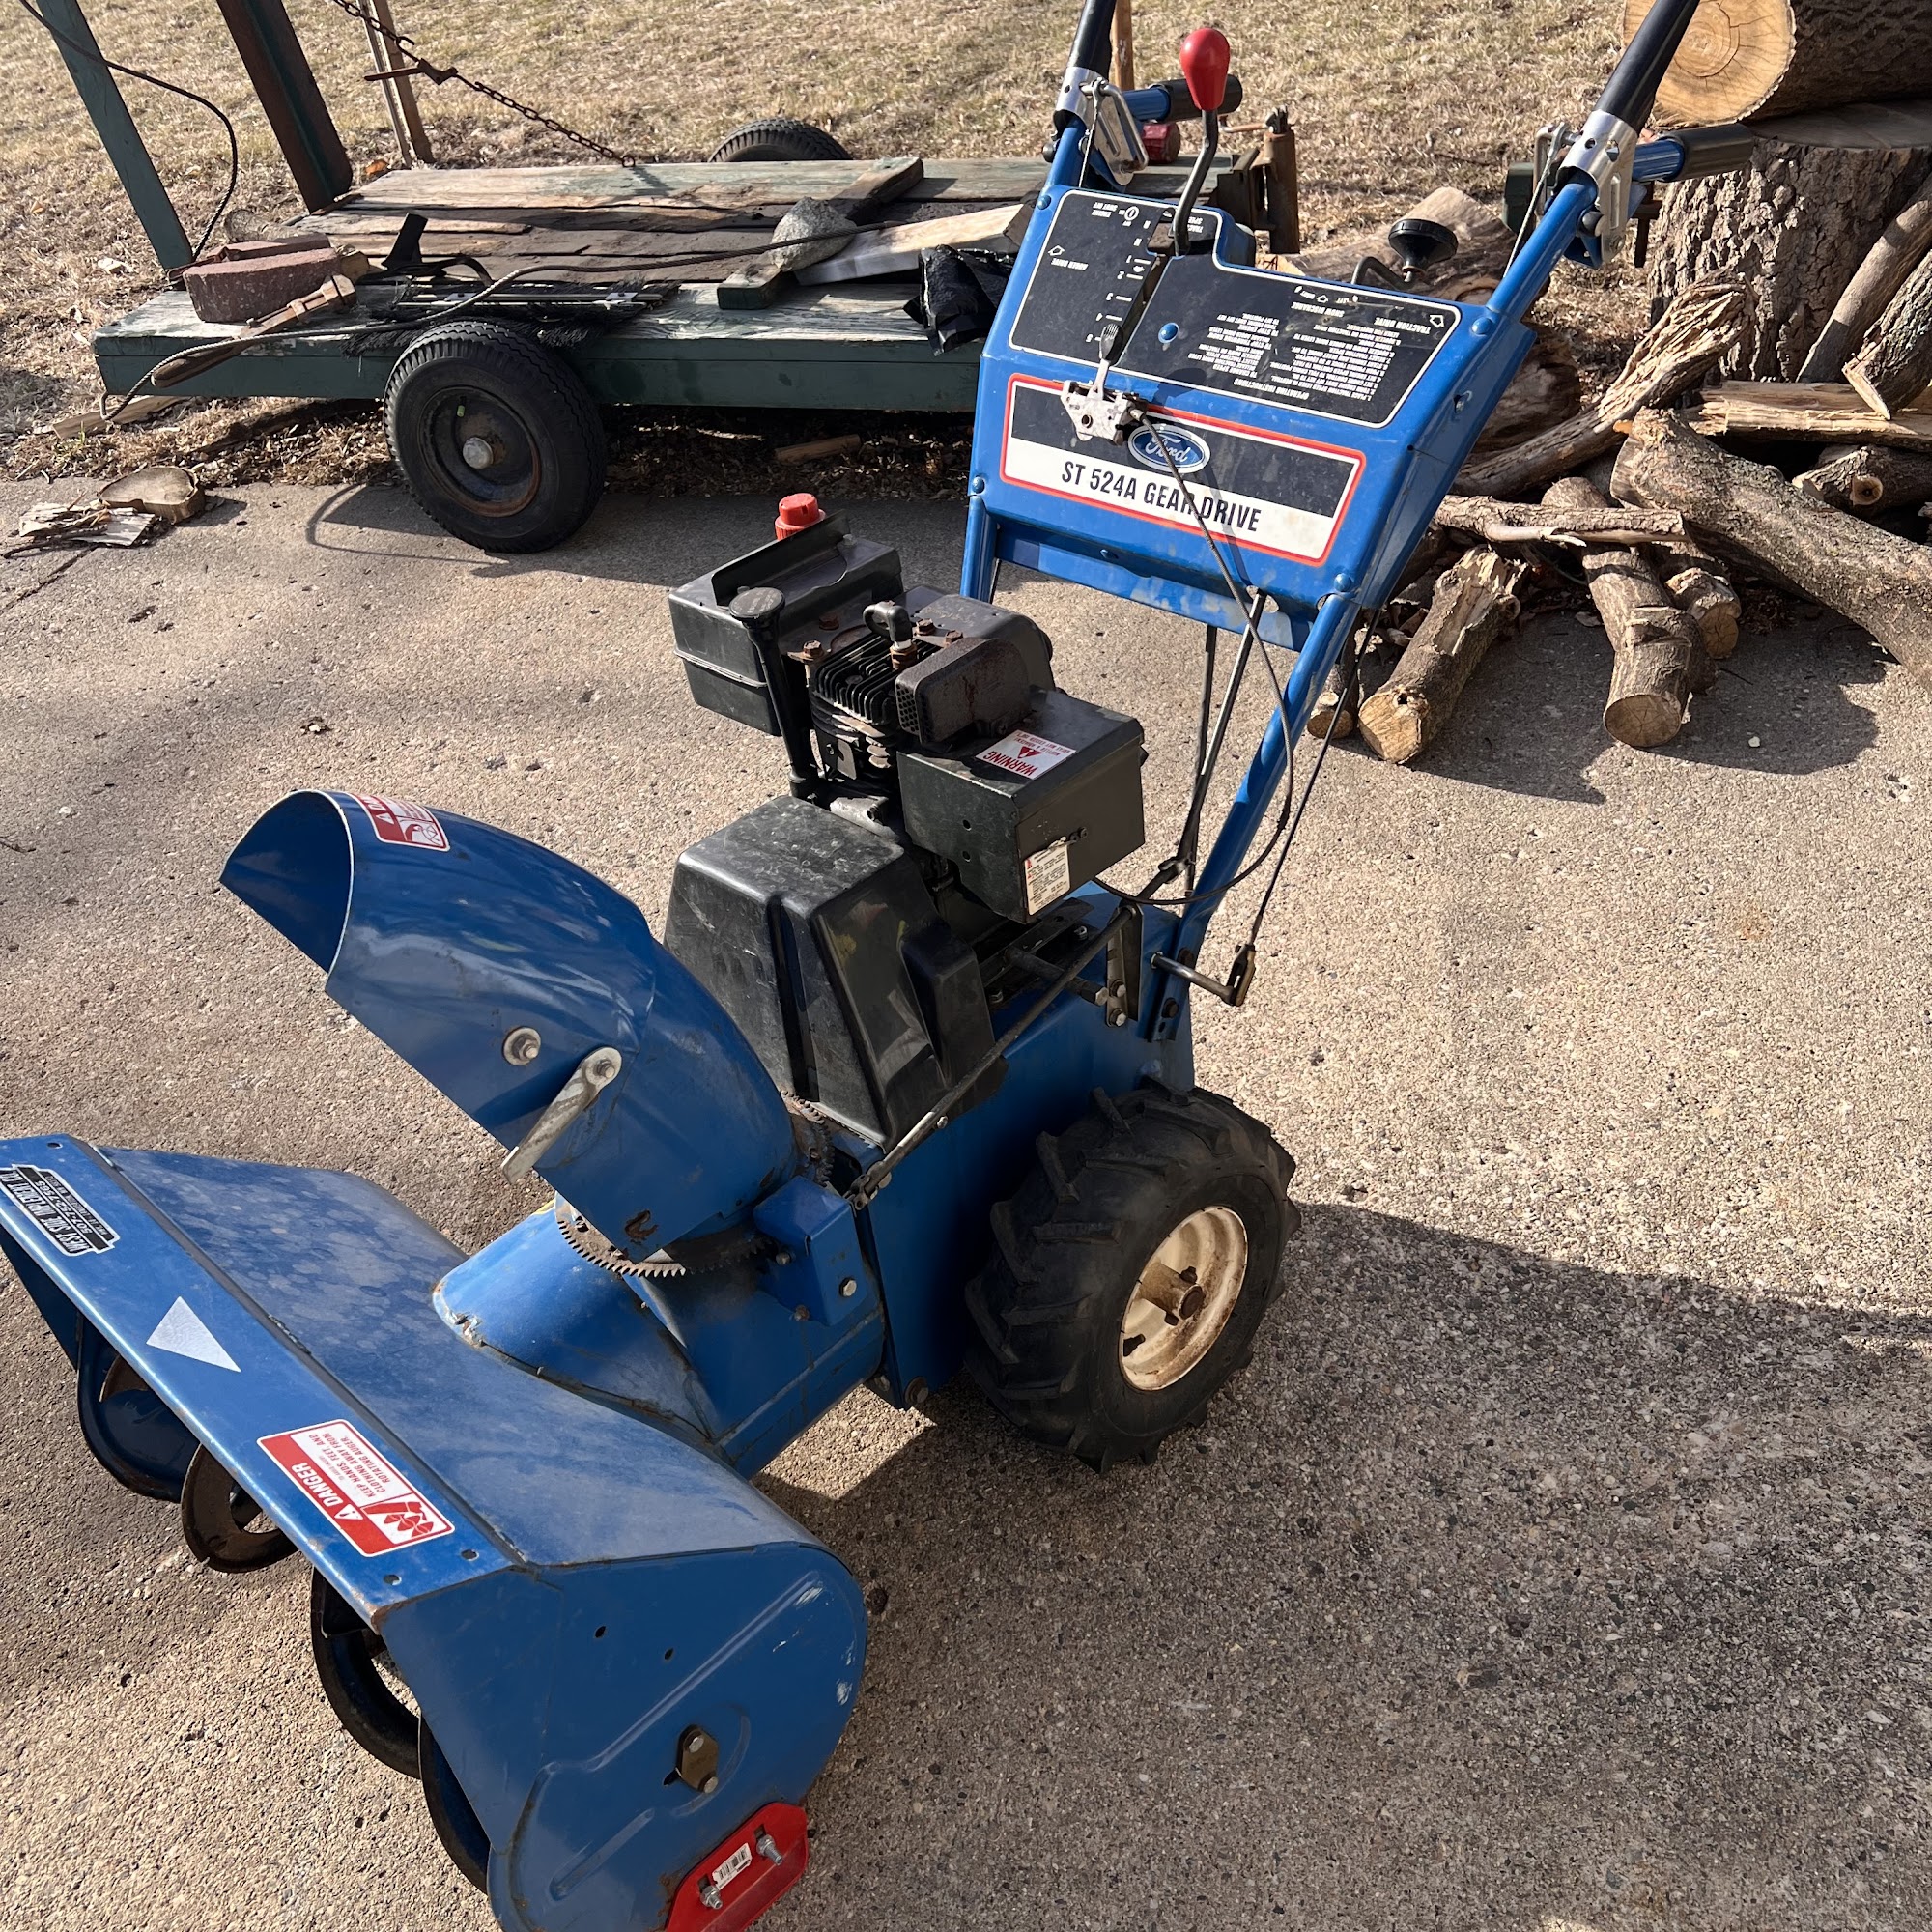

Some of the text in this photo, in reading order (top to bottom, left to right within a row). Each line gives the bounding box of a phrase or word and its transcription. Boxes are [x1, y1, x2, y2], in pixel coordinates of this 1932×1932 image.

[1125, 254, 1131, 263] 1
[1117, 270, 1124, 279] 2
[1105, 292, 1113, 300] 3
[1095, 312, 1102, 321] 4
[1372, 316, 1431, 334] TRACTION DRIVE
[1085, 333, 1093, 342] 5
[1145, 435, 1189, 463] Ford
[1062, 461, 1262, 532] ST 524A GEAR DRIVE
[980, 750, 1039, 776] WARNING
[54, 1232, 91, 1252] WEST
[307, 1433, 326, 1446] AND
[321, 1432, 386, 1492] CLOTHING AWAY FROM
[358, 1455, 391, 1483] ROTATING
[287, 1461, 345, 1507] DANGER
[355, 1482, 377, 1497] KEEP
